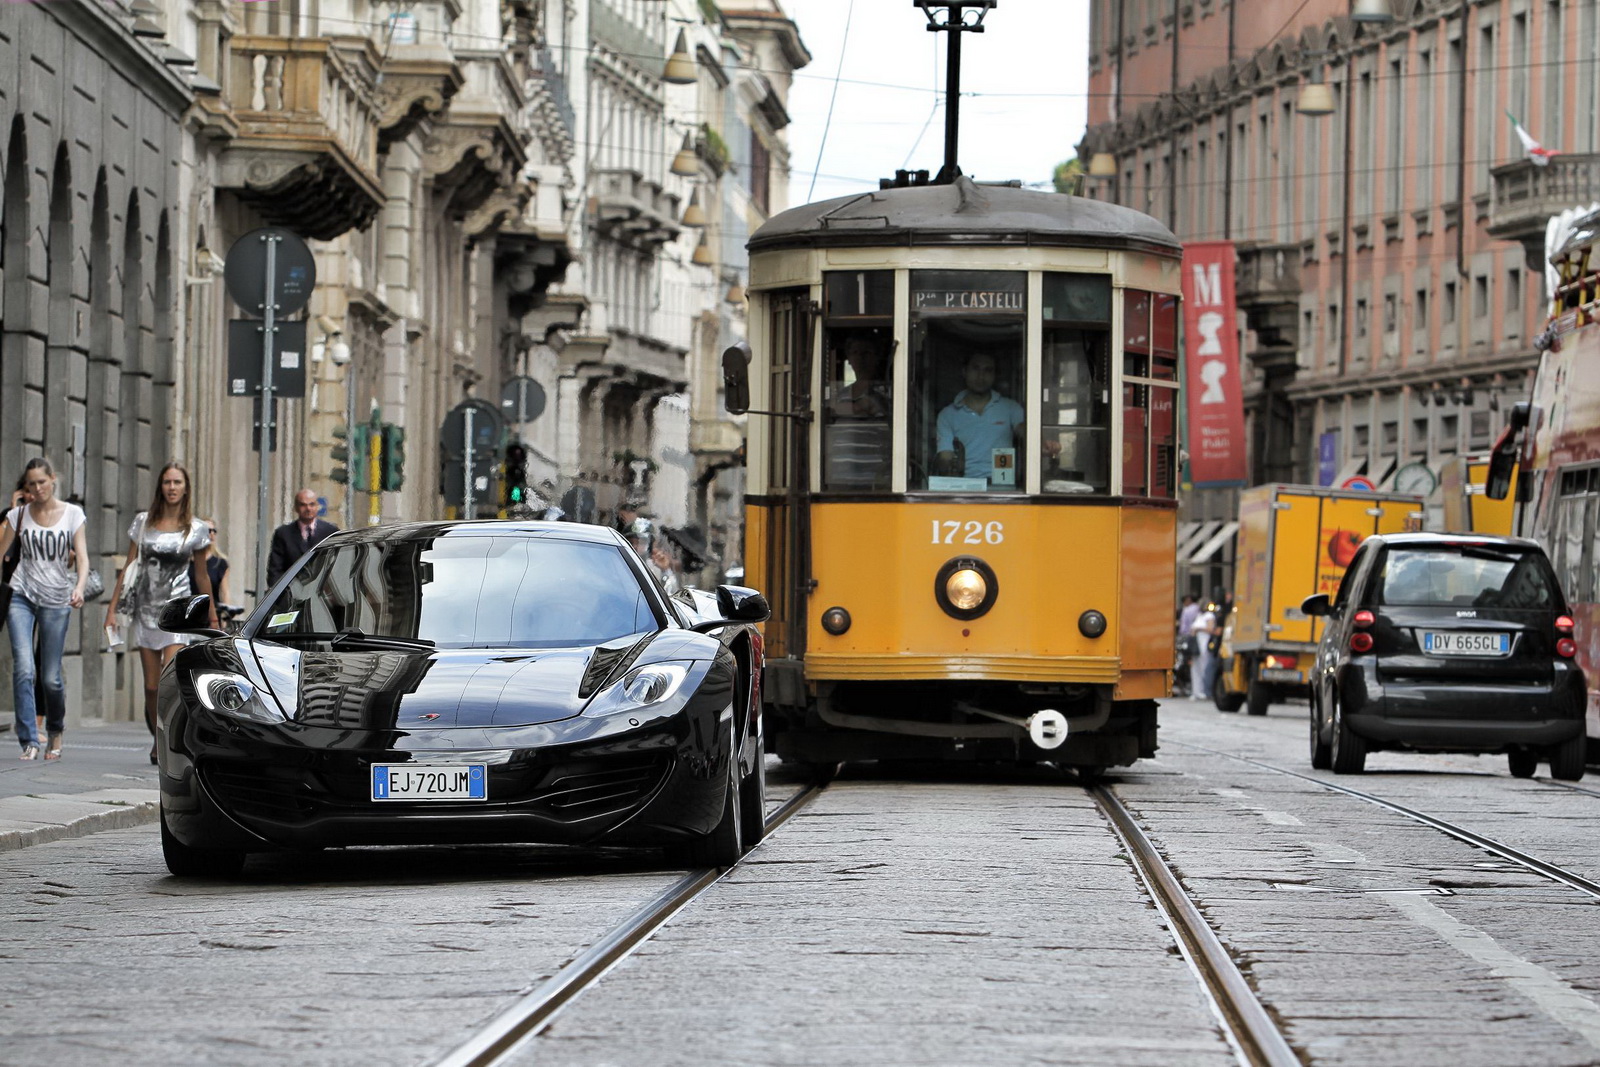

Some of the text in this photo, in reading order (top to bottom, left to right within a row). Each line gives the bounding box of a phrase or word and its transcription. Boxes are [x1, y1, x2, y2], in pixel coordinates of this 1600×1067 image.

[857, 273, 865, 314] 1
[1192, 262, 1222, 306] M
[960, 292, 1023, 308] CASTELLI
[1000, 455, 1007, 467] 9
[1001, 472, 1006, 480] 1
[931, 520, 1004, 545] 1726
[21, 528, 73, 562] ONDO
[1434, 635, 1451, 650] DV
[1456, 635, 1498, 651] 665GL
[389, 772, 410, 793] EJ
[416, 772, 469, 793] 720JM
